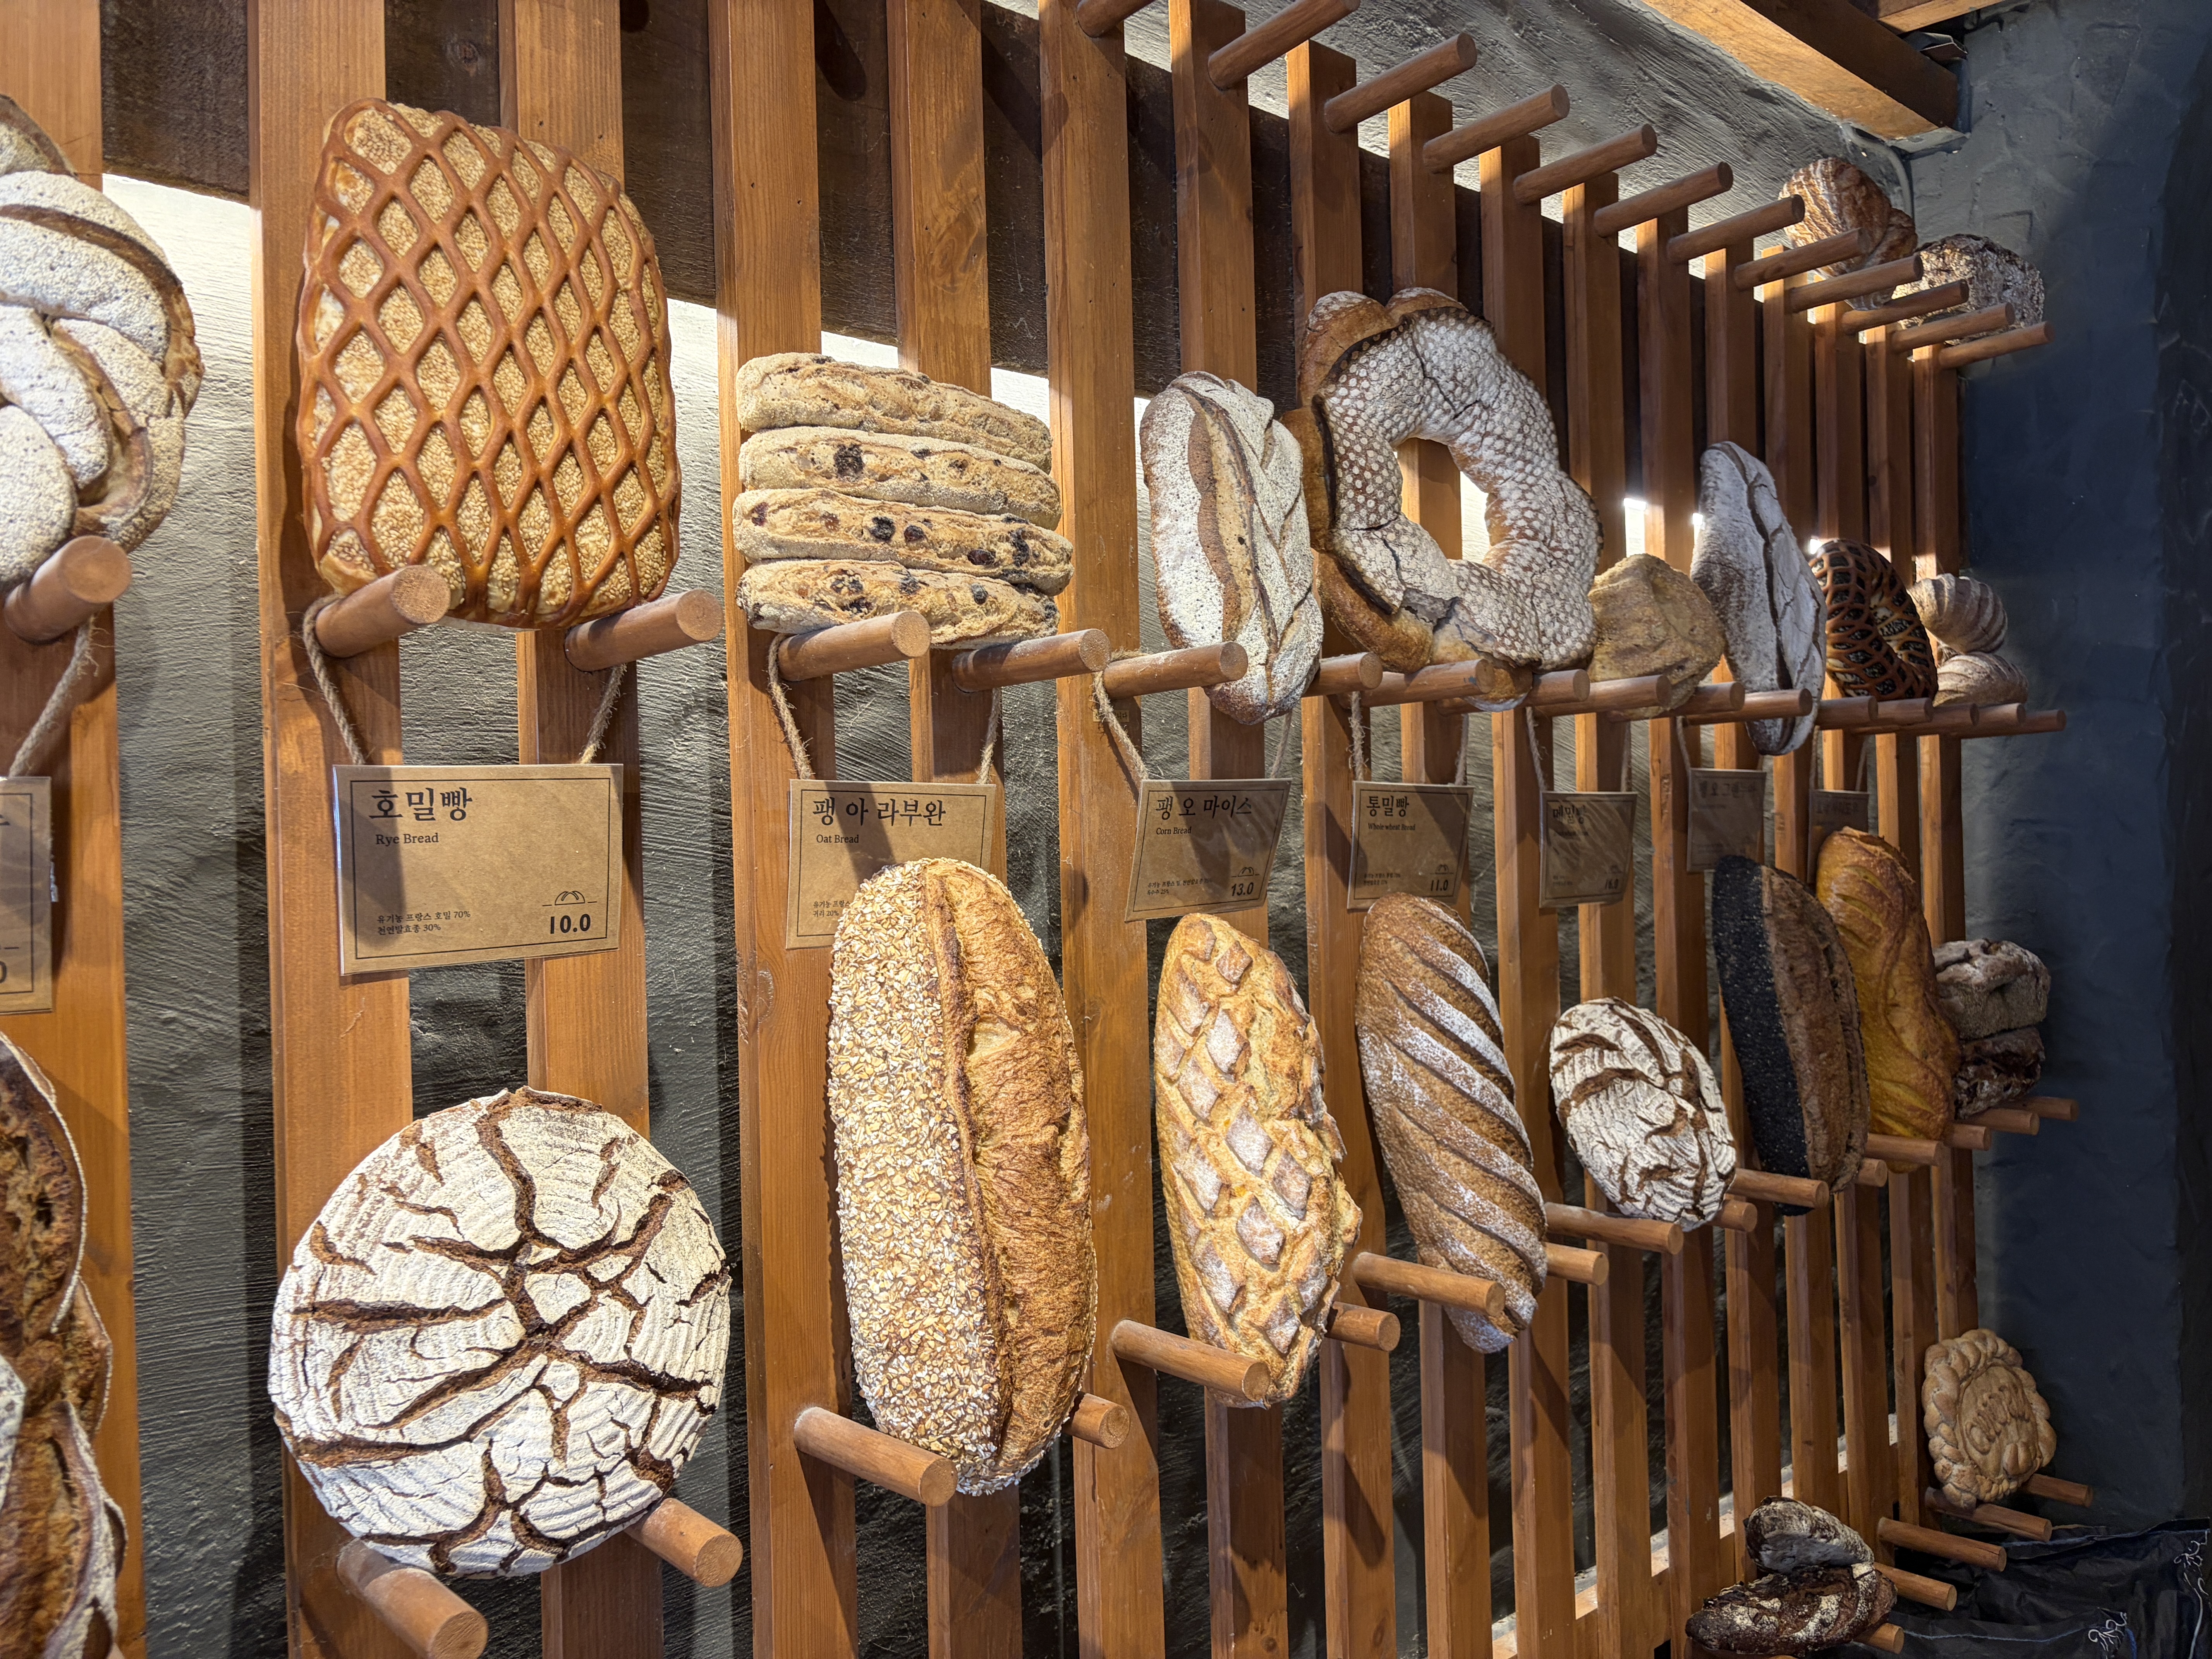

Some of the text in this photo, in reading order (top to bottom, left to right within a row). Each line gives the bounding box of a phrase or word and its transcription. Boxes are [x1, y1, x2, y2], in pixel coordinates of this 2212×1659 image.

[368, 787, 473, 821] 호밀빵
[1155, 795, 1252, 820] 팽 오 마이스
[1366, 795, 1410, 817] 통밀빵
[812, 796, 946, 827] 팽 아 라부완
[1156, 826, 1192, 835] Corn Bread
[1367, 822, 1385, 831] Whole
[1401, 823, 1416, 831] Bread
[375, 832, 439, 847] Rye Bread
[816, 834, 859, 843] Oat Bread
[1231, 882, 1254, 896] 13.0
[1430, 879, 1449, 891] 11.0
[812, 899, 850, 908] 유기농 프랑스
[376, 910, 471, 924] 유기농 프랑스 호밀 70%
[812, 909, 825, 918] 귀리
[377, 924, 441, 936] 천연발효종 30%
[550, 913, 591, 934] 10.0
